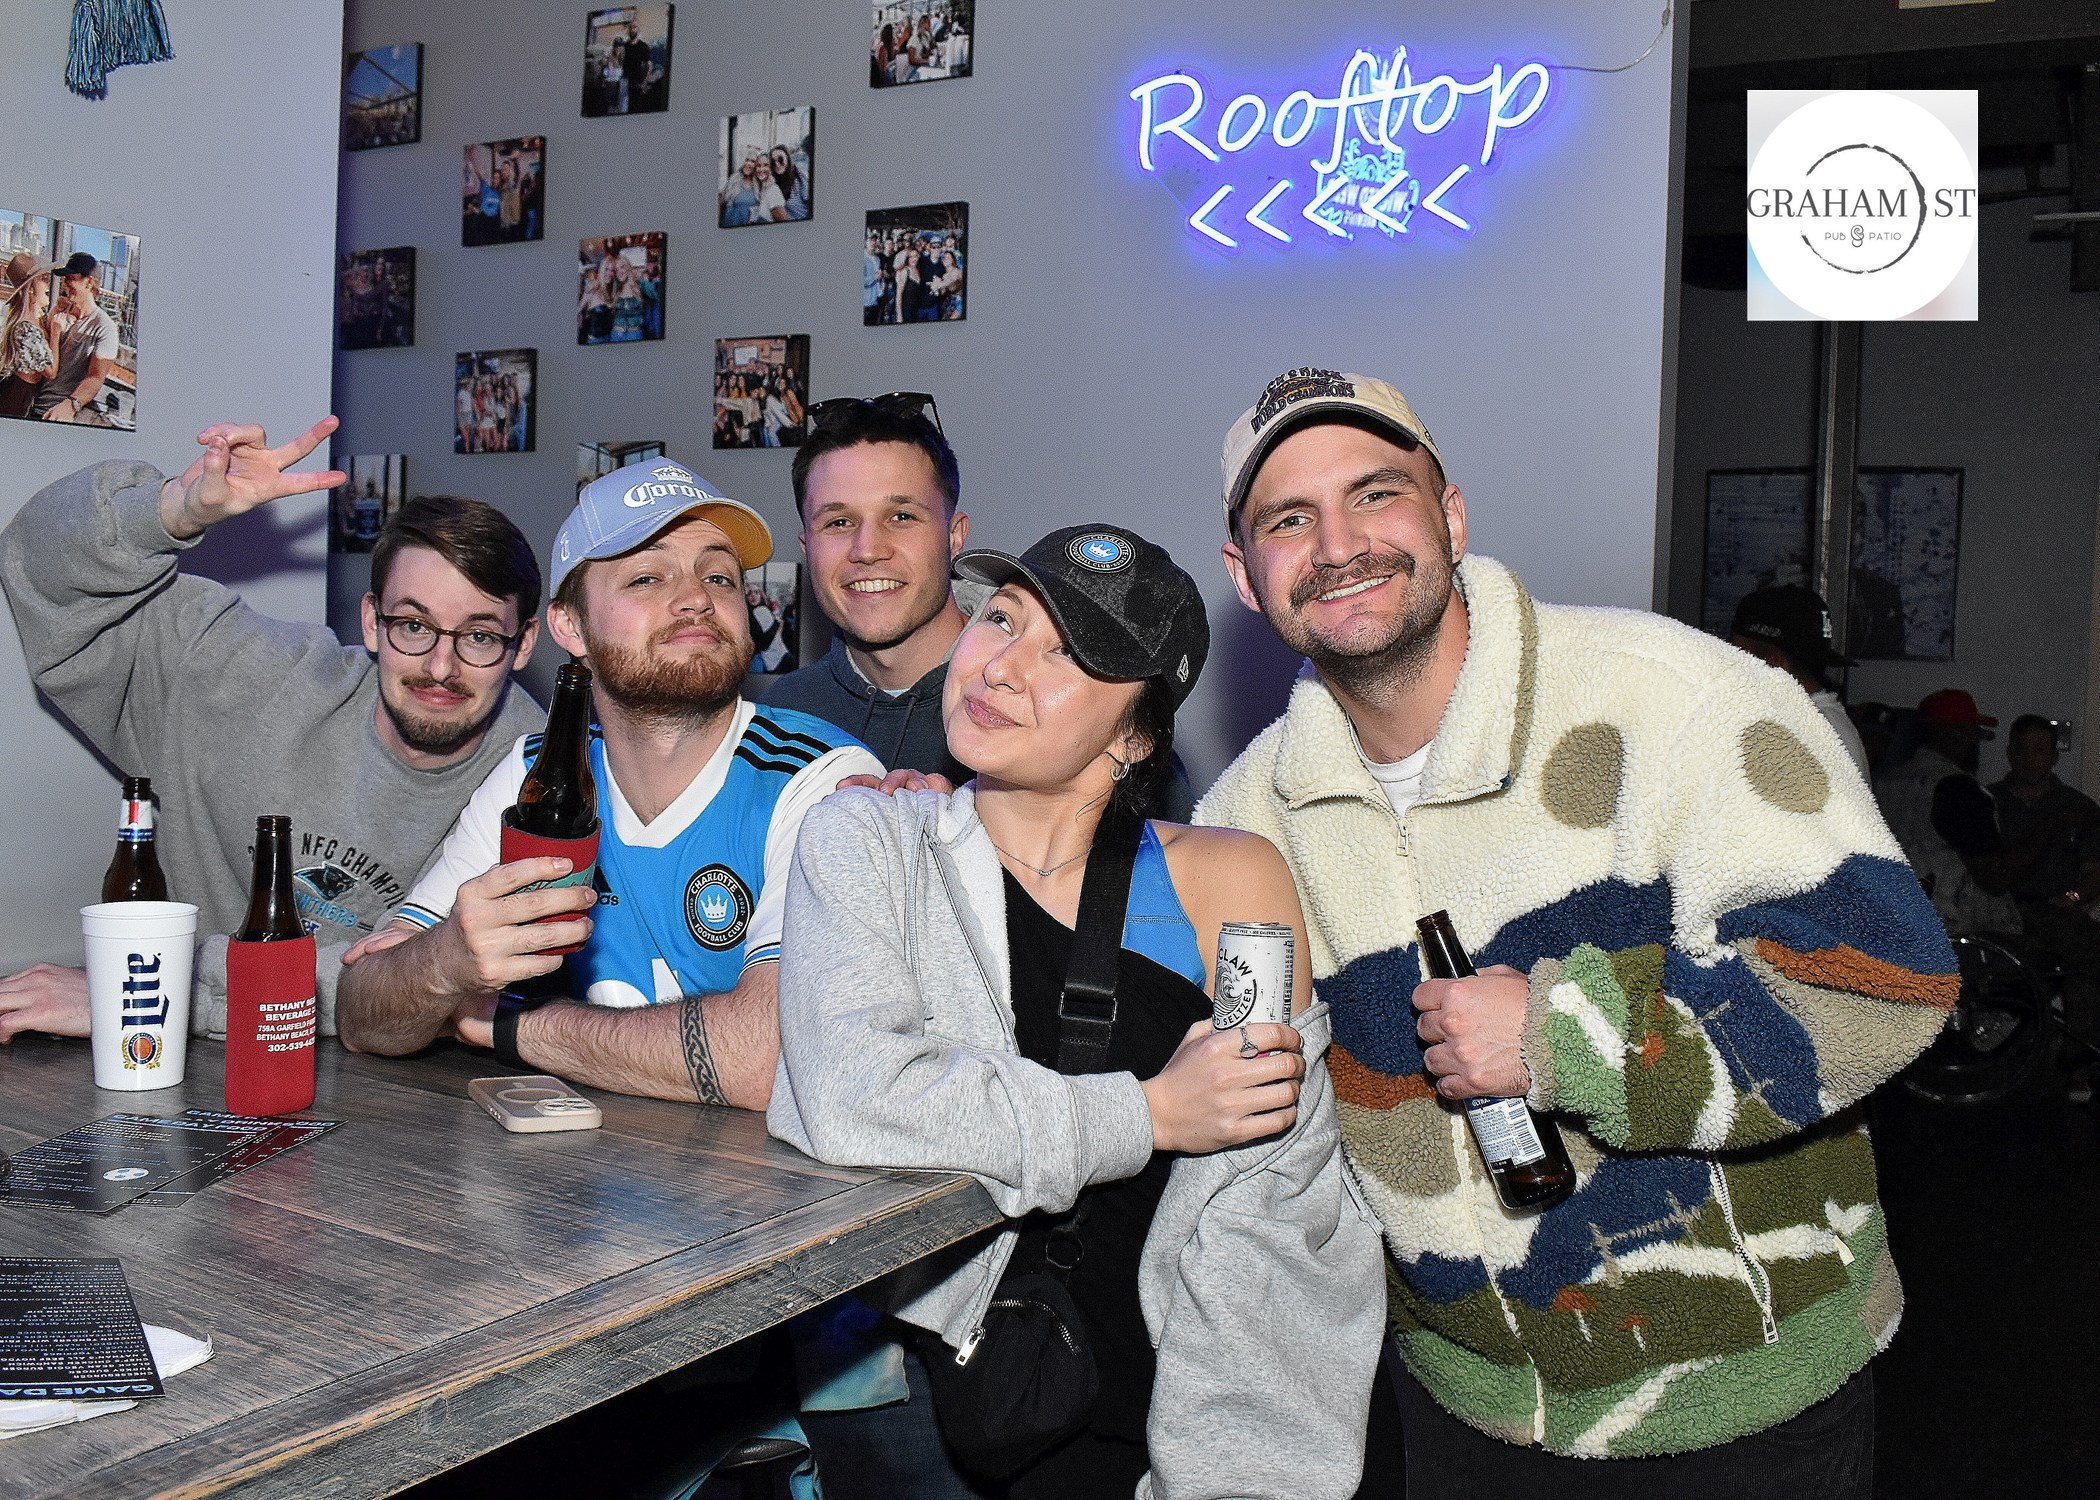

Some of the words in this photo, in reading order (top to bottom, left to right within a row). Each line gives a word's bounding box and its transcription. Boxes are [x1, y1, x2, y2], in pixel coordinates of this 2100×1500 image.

[1130, 45, 1550, 172] Rooftop
[623, 482, 714, 508] Coron
[301, 833, 338, 860] NFC
[691, 872, 738, 895] CHARLOTTE
[294, 889, 358, 927] ANTHERS
[694, 923, 728, 942] FOOTBALL
[727, 920, 744, 938] CLUB
[1217, 947, 1253, 977] CLAW
[121, 952, 170, 1031] Lite
[259, 1000, 306, 1012] BETHANY
[265, 1008, 312, 1022] BEVERAGE
[1223, 988, 1253, 1026] SELTZER
[256, 1032, 290, 1041] BETHANY
[53, 1385, 154, 1395] GAME
